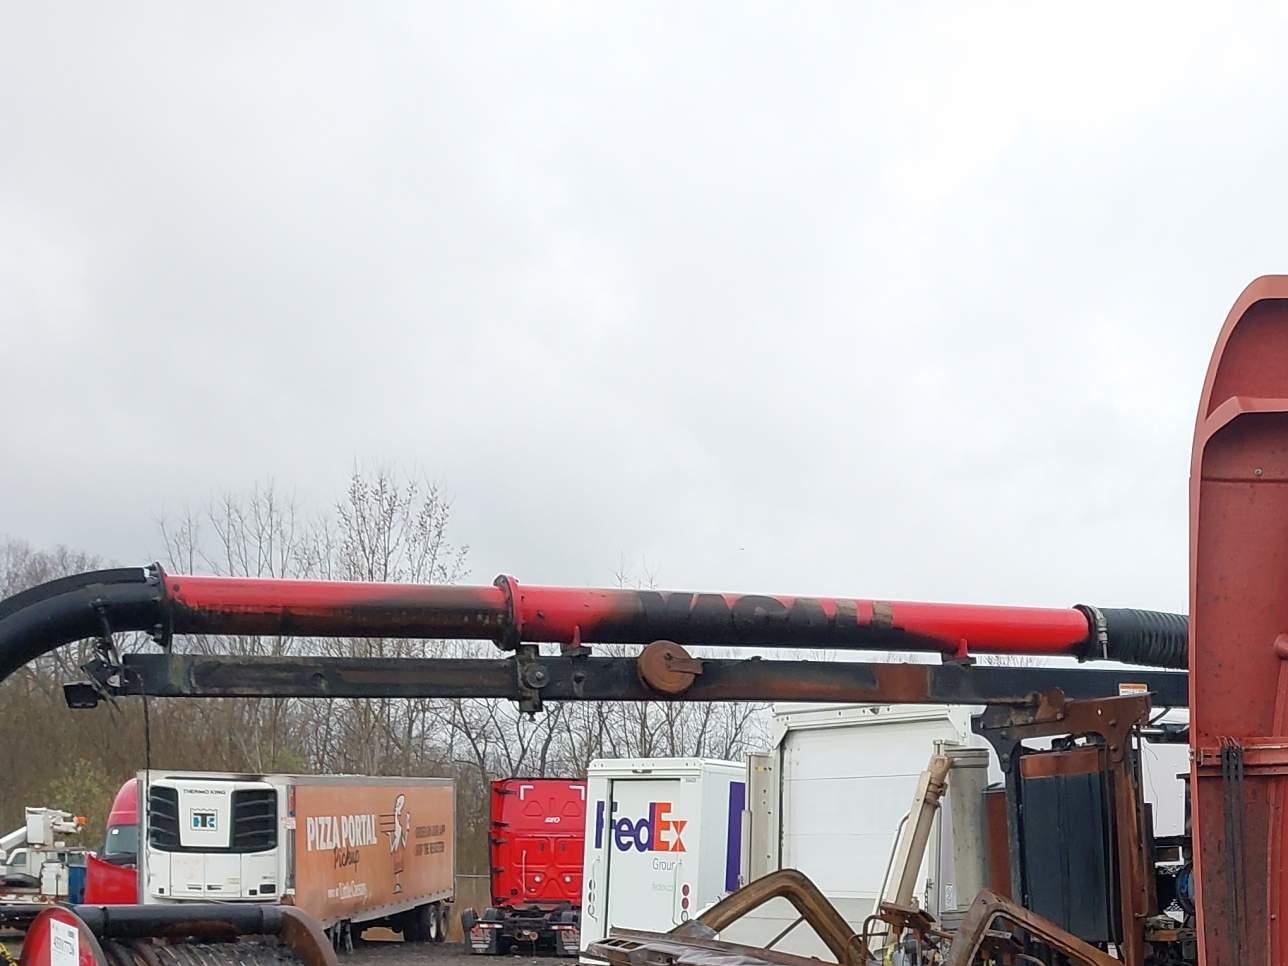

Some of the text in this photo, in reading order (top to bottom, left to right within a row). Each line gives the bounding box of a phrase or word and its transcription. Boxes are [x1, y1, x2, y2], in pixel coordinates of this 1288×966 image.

[306, 815, 341, 851] PIZZA
[341, 814, 377, 848] PORTAL
[595, 801, 688, 853] FedEx
[333, 846, 360, 872] Pickup
